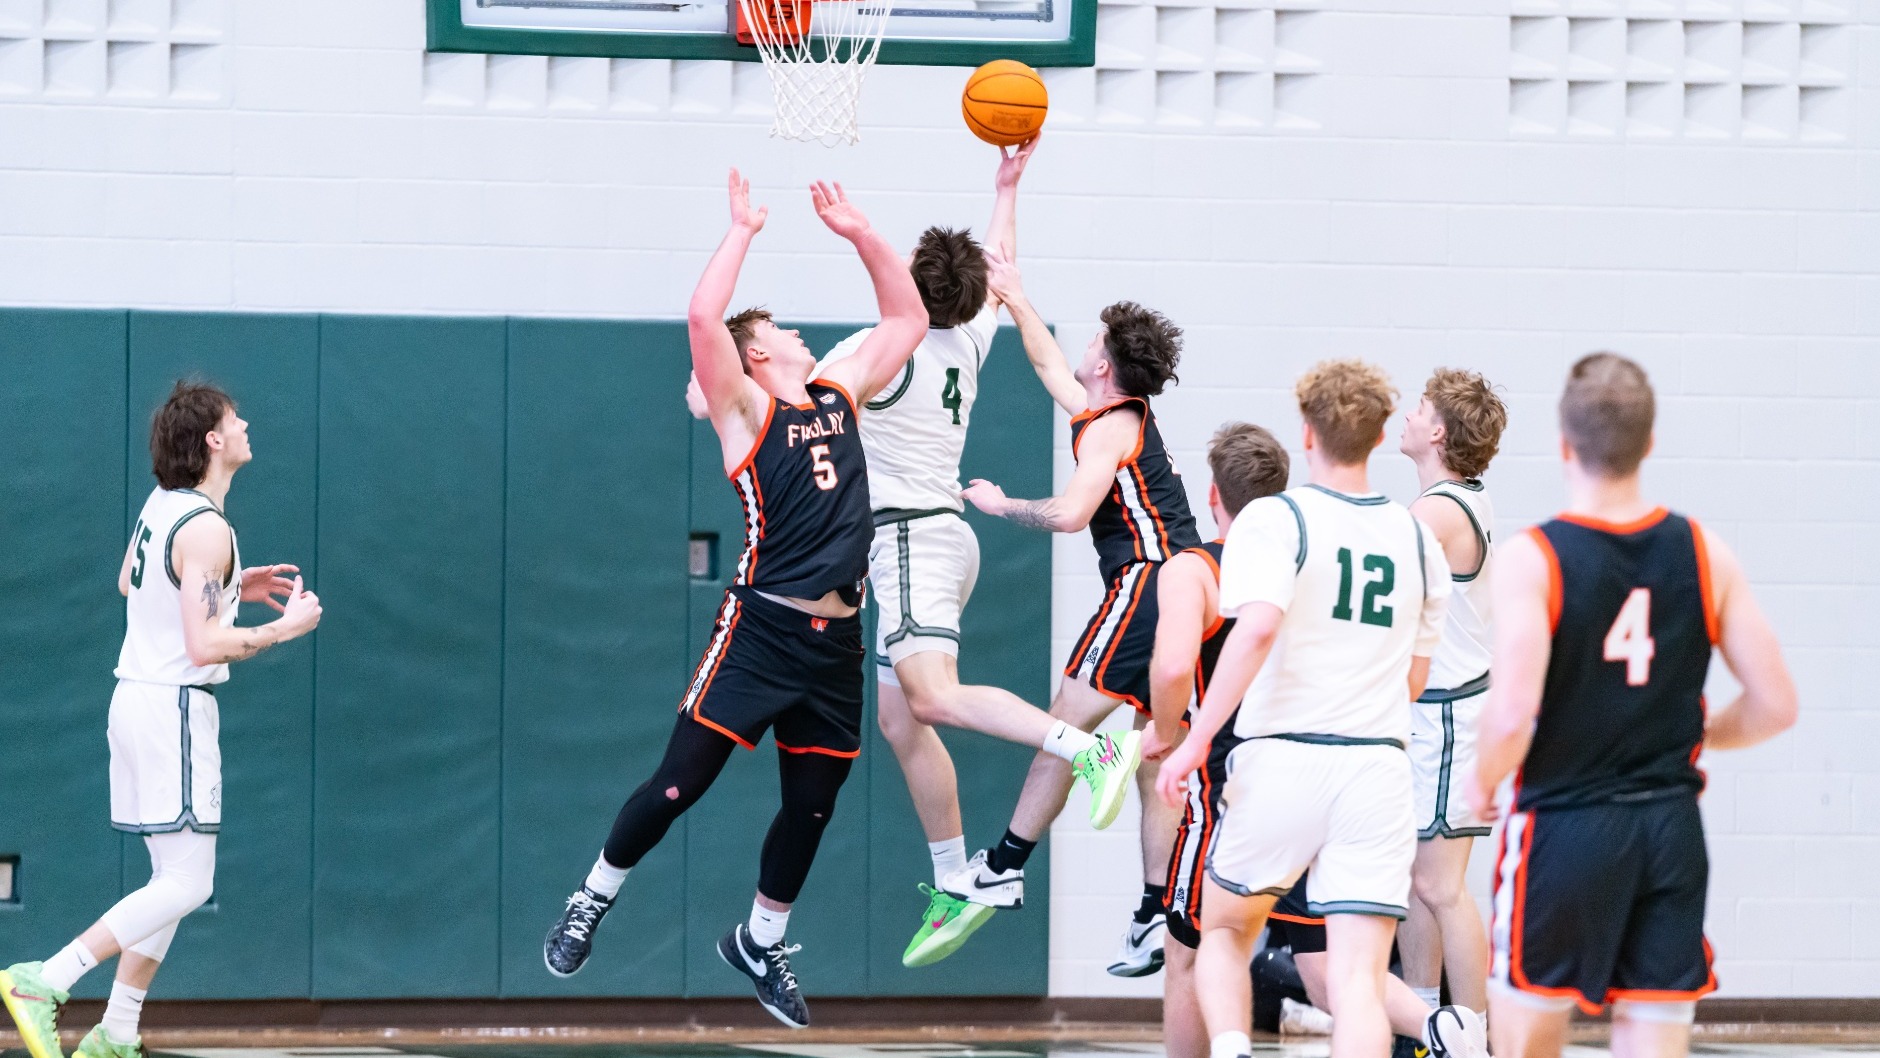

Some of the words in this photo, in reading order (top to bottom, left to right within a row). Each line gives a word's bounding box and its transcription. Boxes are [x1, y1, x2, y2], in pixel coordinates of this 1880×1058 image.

[941, 367, 962, 425] 4
[809, 443, 839, 490] 5
[1331, 546, 1395, 628] 12
[1602, 586, 1656, 687] 4
